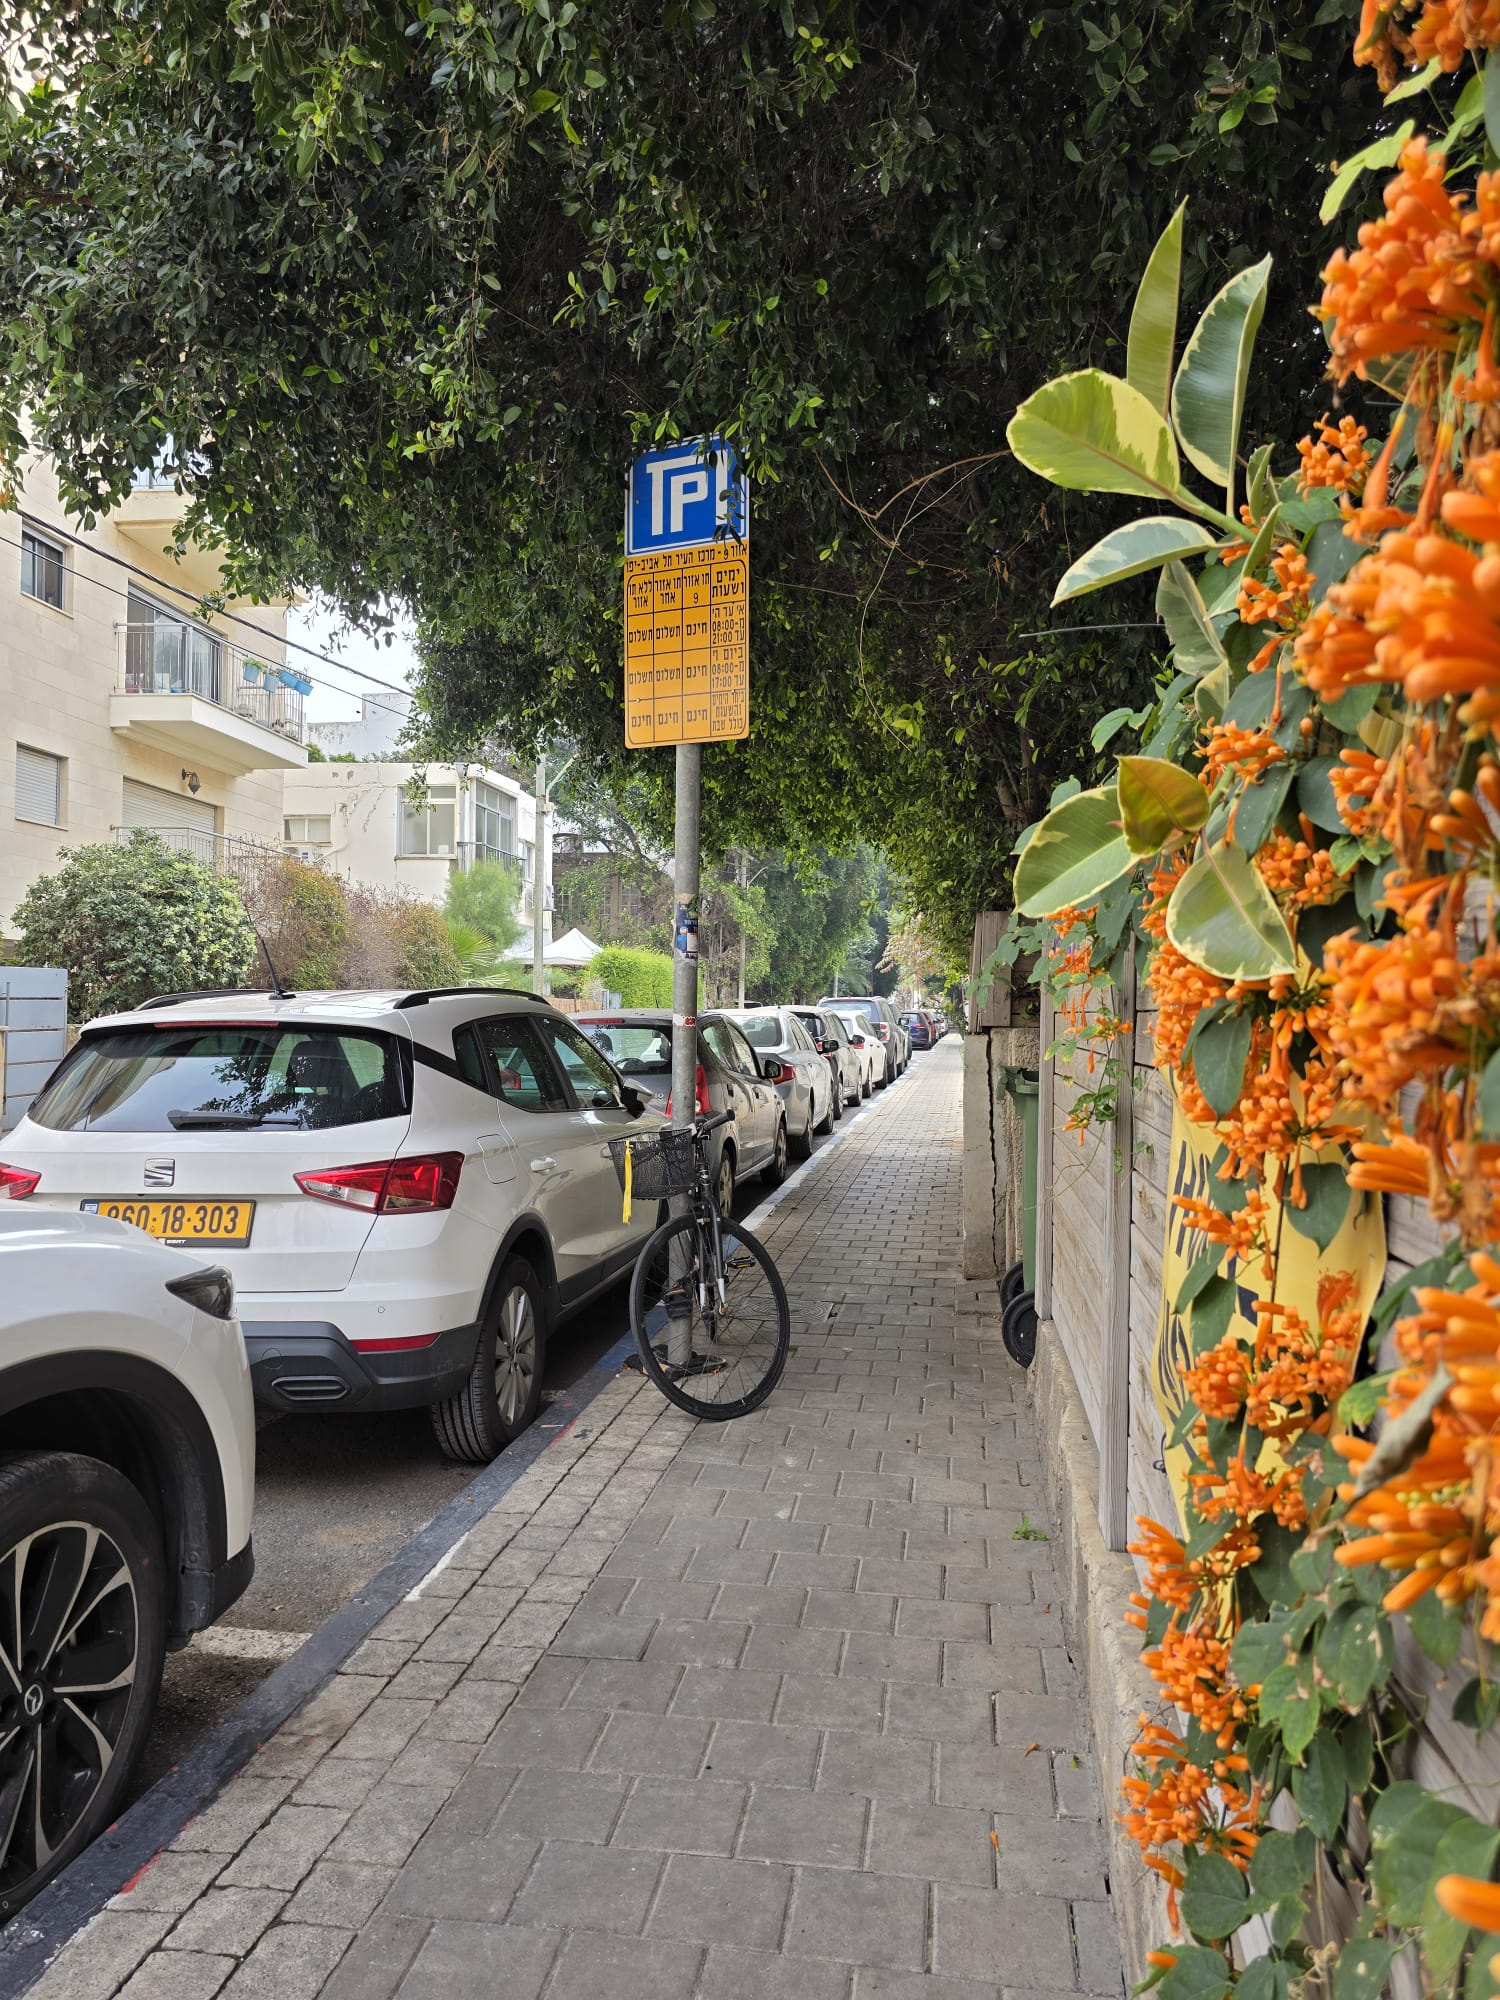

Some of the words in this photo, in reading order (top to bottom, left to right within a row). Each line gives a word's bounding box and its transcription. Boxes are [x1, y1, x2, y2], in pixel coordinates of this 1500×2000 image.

[698, 549, 715, 562] מרכז
[724, 549, 729, 560] 9
[731, 543, 747, 557] אזור
[662, 554, 672, 567] תל
[676, 552, 693, 565] העיר
[684, 574, 700, 587] אזור
[702, 572, 710, 585] תו
[716, 568, 740, 582] ימים
[638, 580, 652, 594] ללא
[655, 578, 671, 591] אזור
[674, 576, 682, 589] תו
[712, 582, 745, 598] ושעות
[633, 596, 648, 608] אזור
[660, 592, 676, 604] אחר
[693, 592, 699, 603] 9
[723, 606, 734, 617] עד
[628, 628, 652, 643] תשלום
[656, 625, 680, 639] תשלום
[686, 622, 707, 636] חינם
[735, 629, 744, 641] עד
[712, 632, 732, 644] 21:00
[724, 646, 743, 660] ביום
[628, 670, 653, 685] תשלום
[656, 667, 680, 682] תשלום
[686, 665, 707, 678] חינם
[712, 676, 732, 689] 17:00
[734, 674, 744, 686] עד
[687, 709, 708, 722] חינם
[716, 704, 741, 718] והשעות
[631, 714, 651, 728] חינם
[658, 712, 678, 725] חינם
